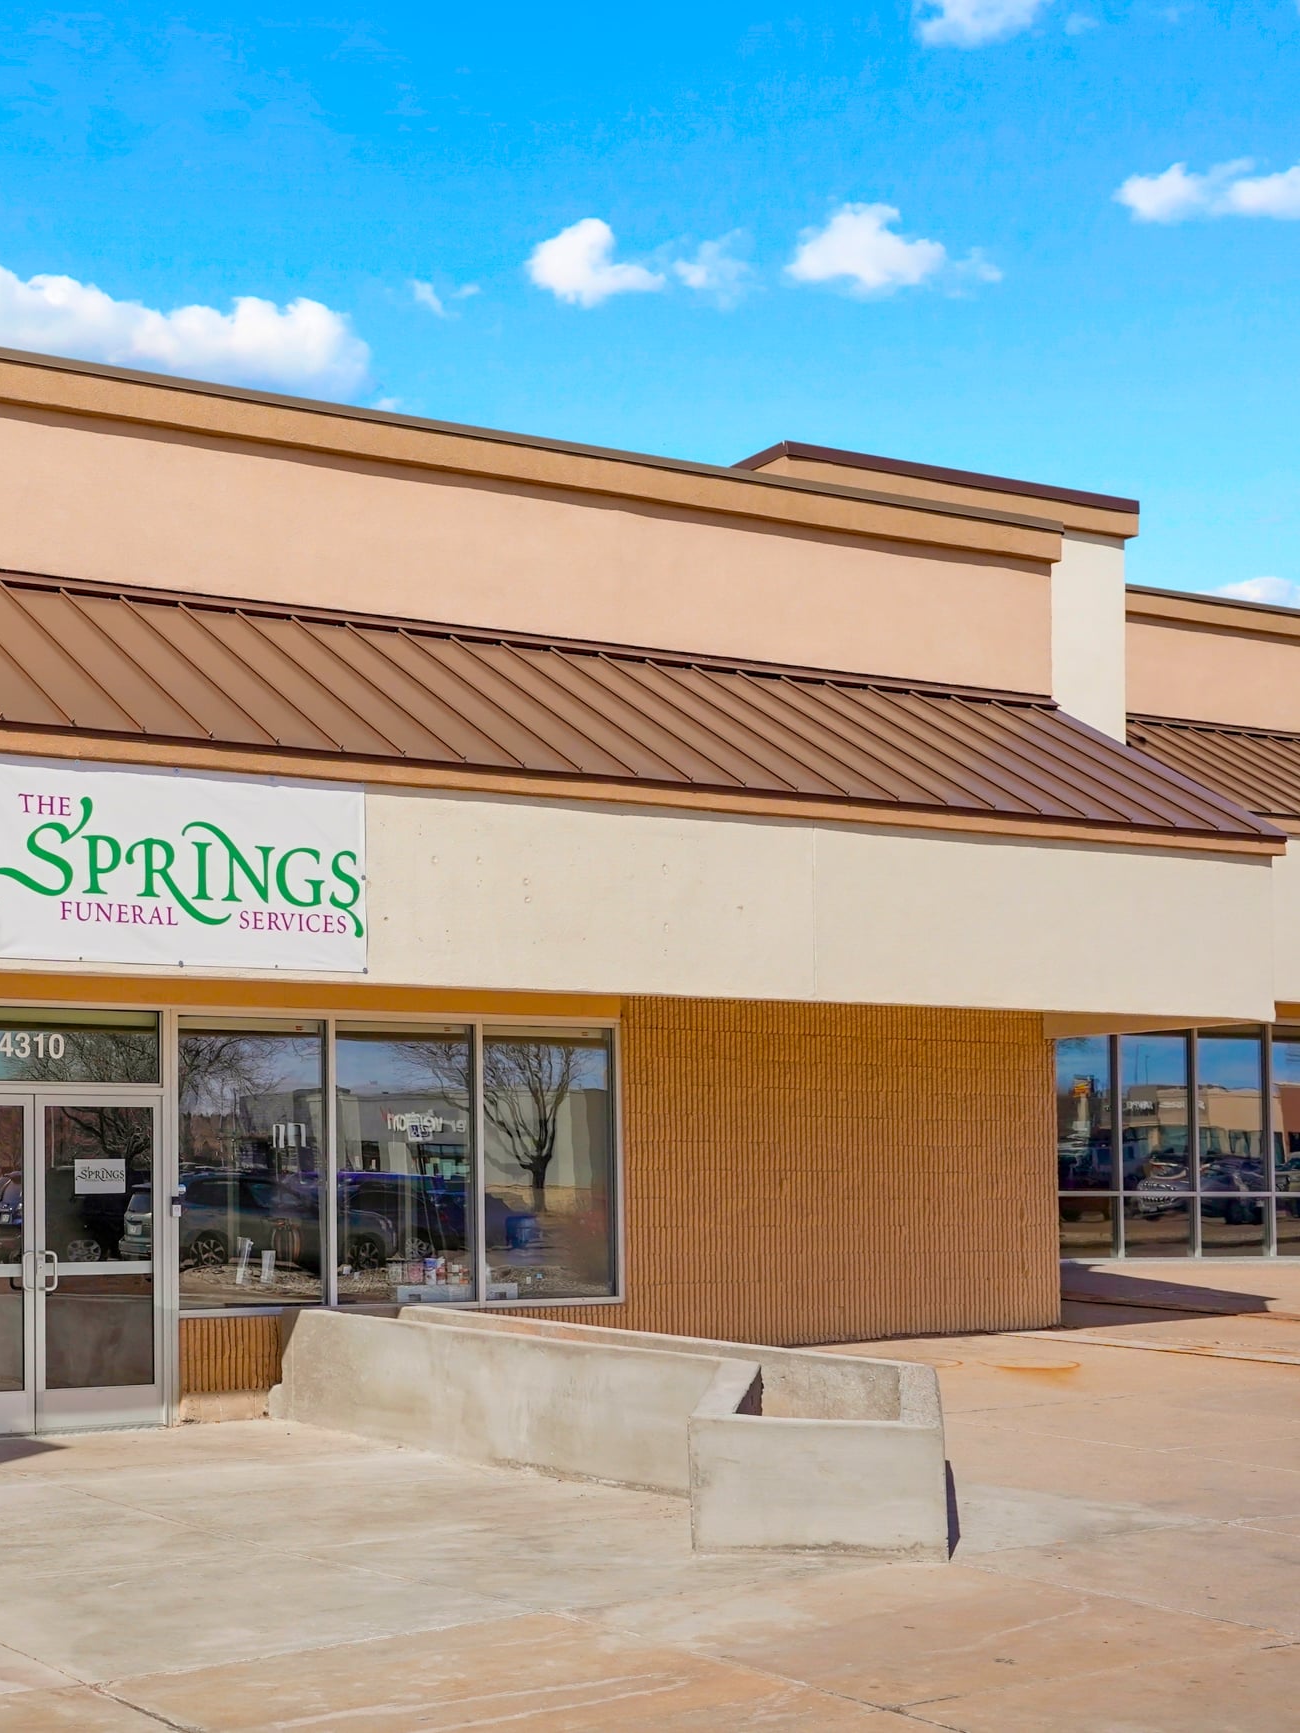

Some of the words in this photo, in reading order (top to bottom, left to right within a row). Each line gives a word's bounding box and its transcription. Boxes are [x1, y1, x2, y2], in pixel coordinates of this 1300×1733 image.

[18, 793, 72, 817] THE
[60, 901, 179, 926] FUNERAL
[239, 910, 348, 934] SERVICES
[76, 1166, 124, 1182] SPRINGS
